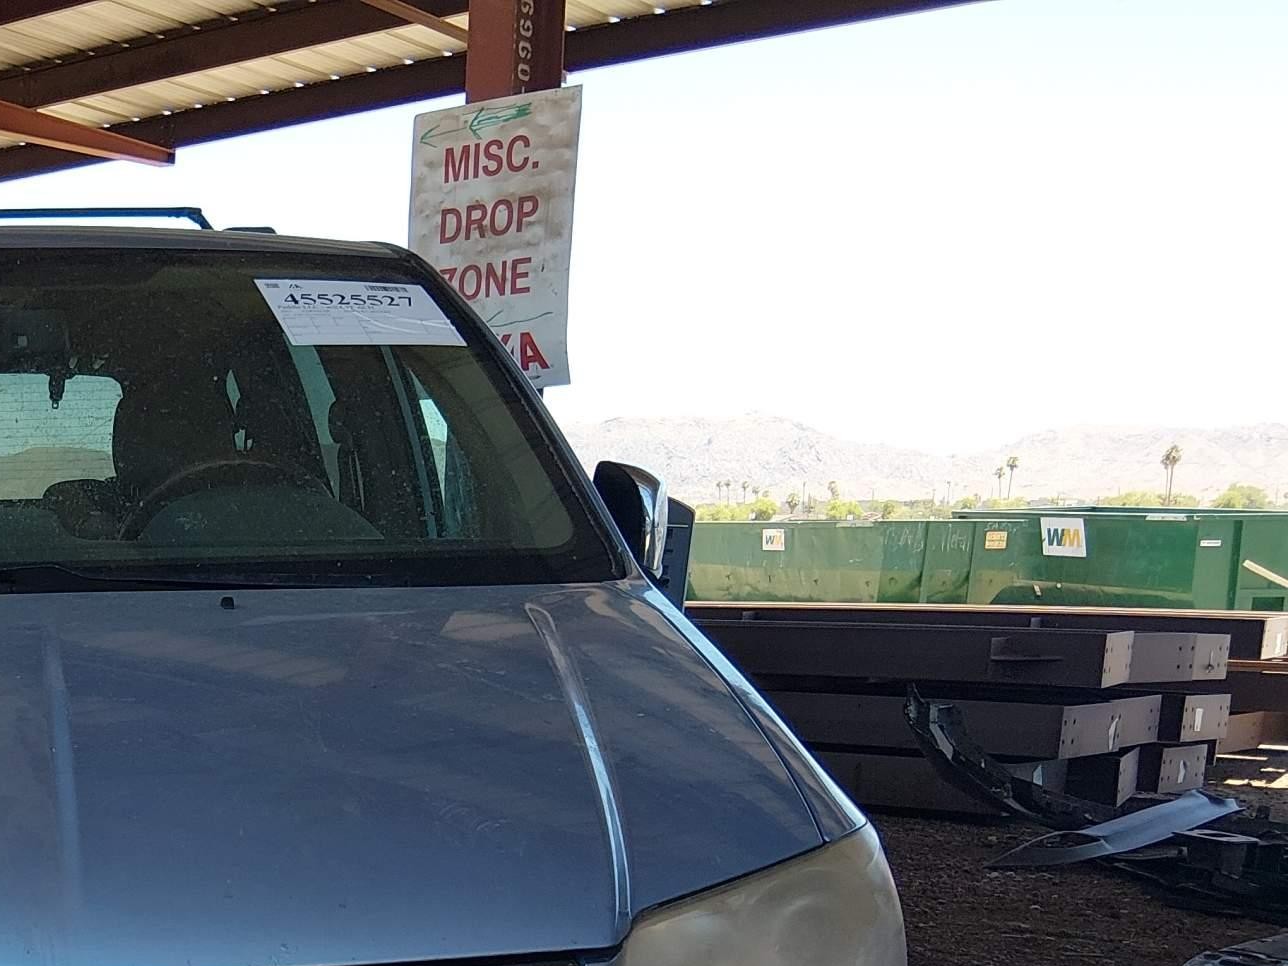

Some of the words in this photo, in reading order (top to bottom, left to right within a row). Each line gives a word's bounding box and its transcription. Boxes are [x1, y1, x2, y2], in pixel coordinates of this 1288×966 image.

[444, 135, 539, 184] MISC.
[440, 195, 539, 244] DROP
[284, 293, 412, 307] 45525527
[1047, 527, 1081, 547] WM
